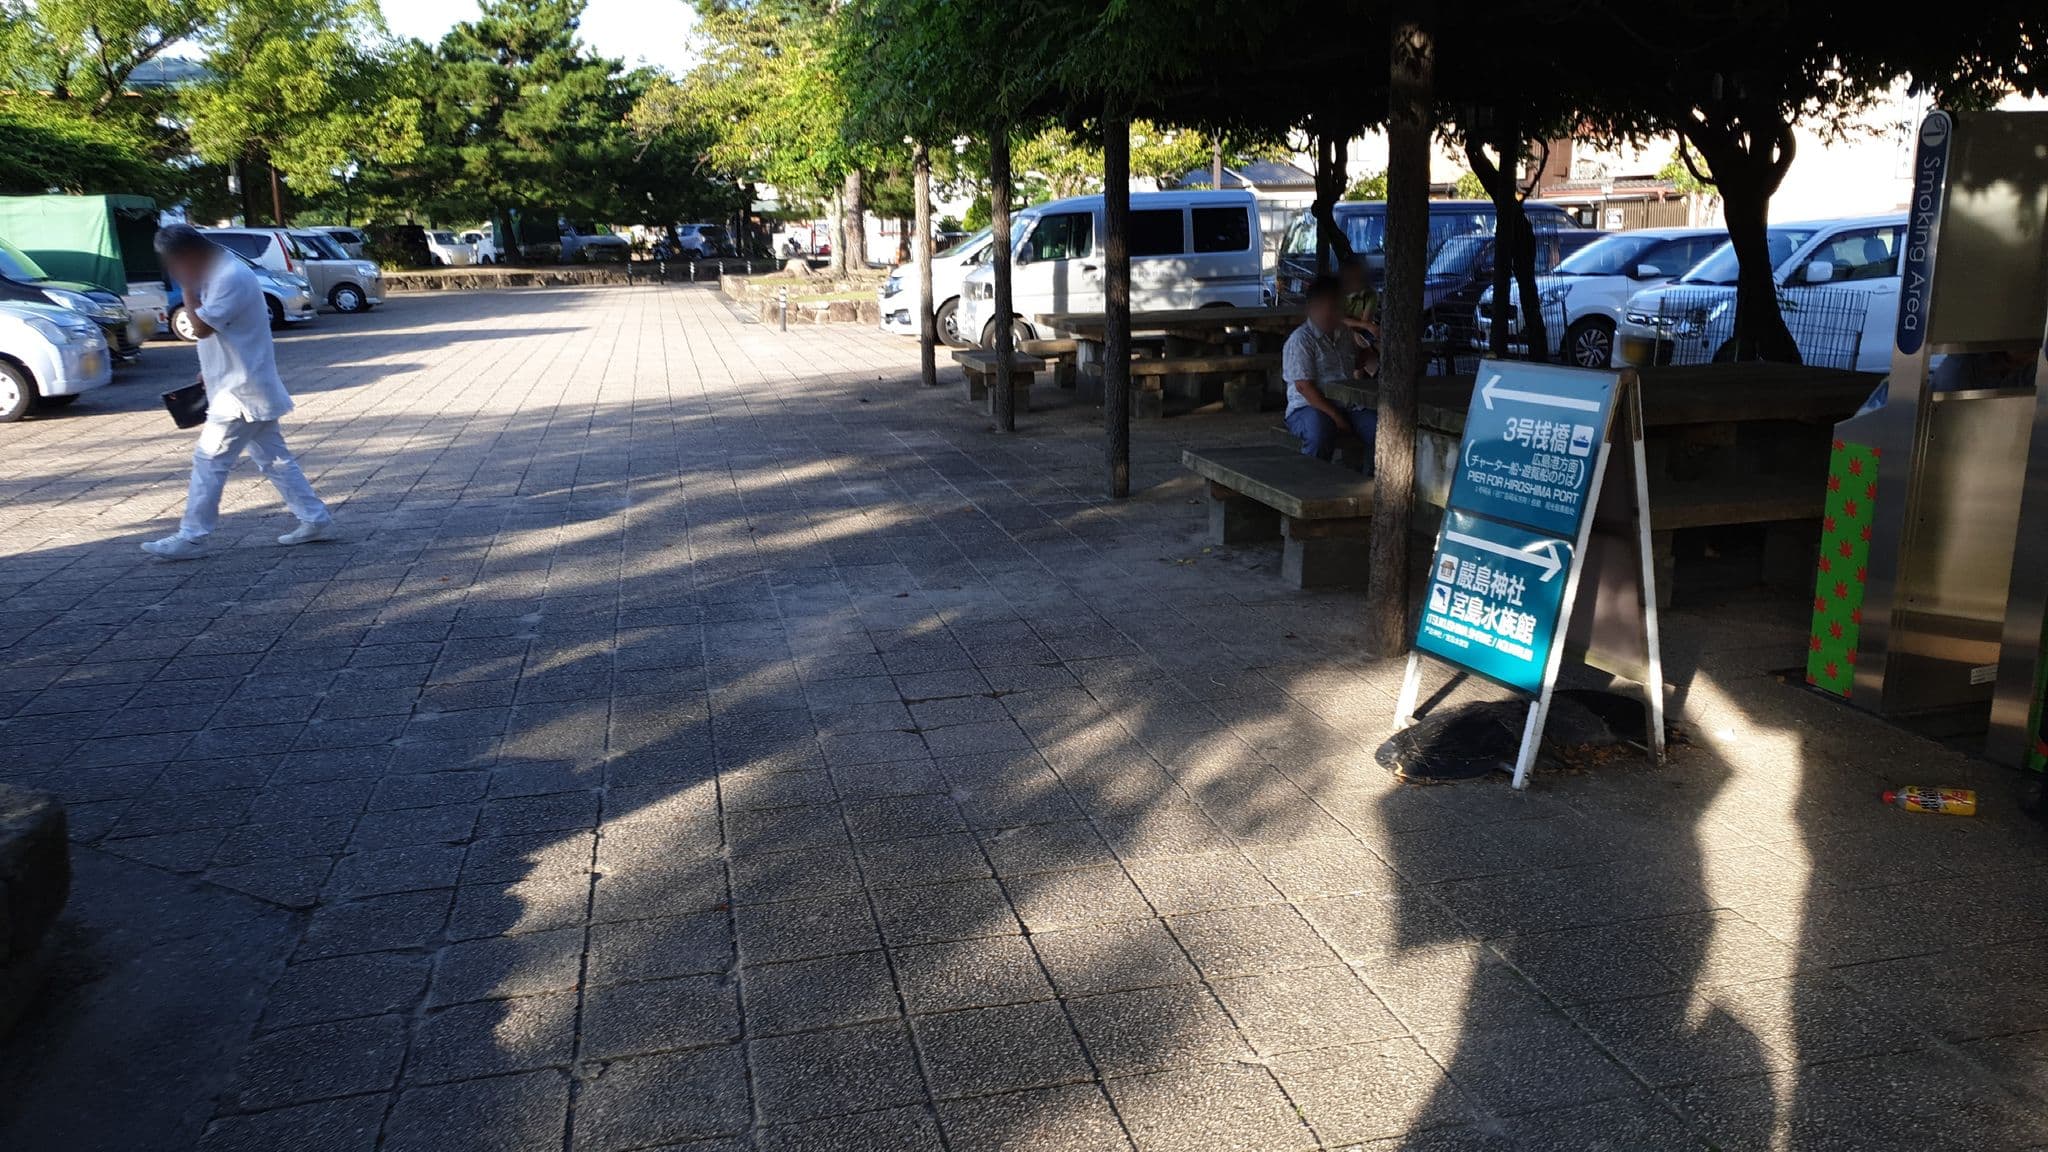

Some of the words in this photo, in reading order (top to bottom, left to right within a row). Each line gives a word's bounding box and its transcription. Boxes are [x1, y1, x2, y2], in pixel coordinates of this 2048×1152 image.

[1909, 156, 1941, 263] Smoking
[1904, 271, 1926, 331] Area
[1503, 417, 1571, 455] 3号桟橋
[1467, 470, 1486, 484] PIER
[1486, 474, 1504, 488] FOR
[1504, 477, 1552, 499] HIROSHIMA
[1553, 488, 1579, 504] PORT
[1449, 591, 1537, 646] 宮島水族館
